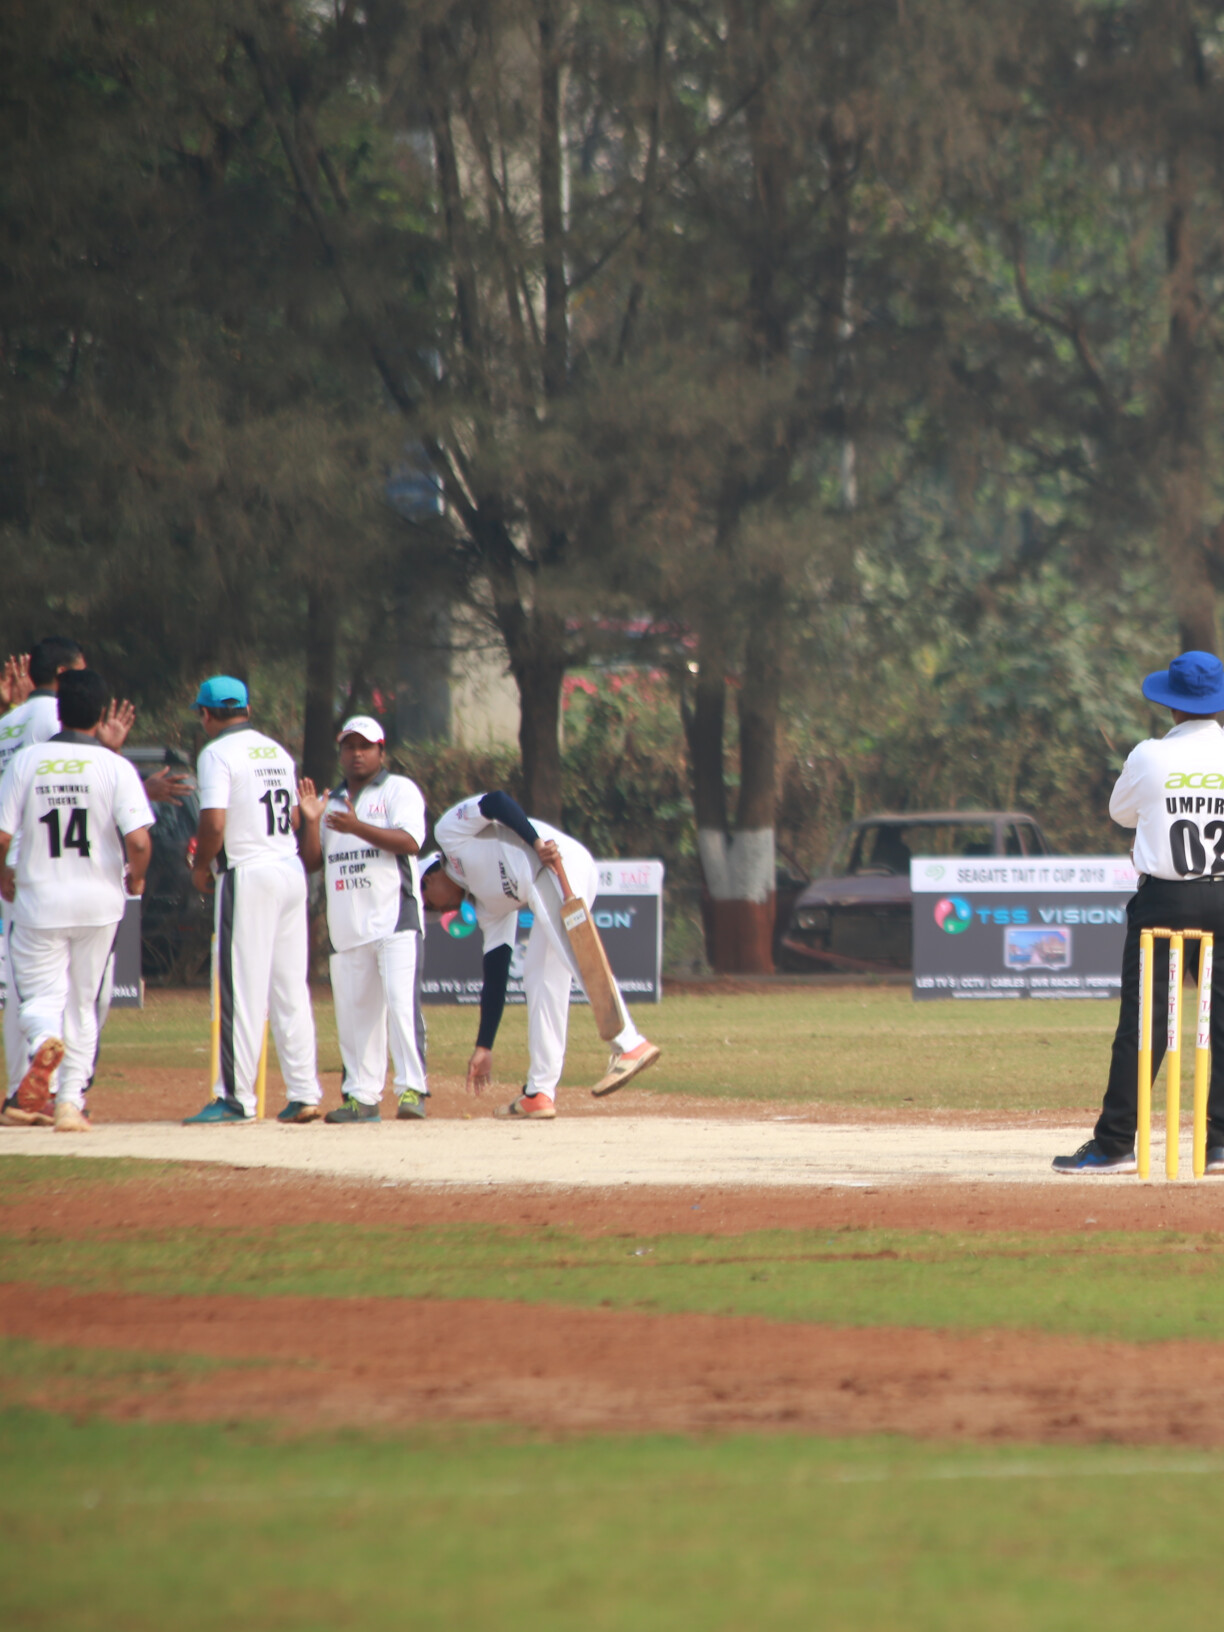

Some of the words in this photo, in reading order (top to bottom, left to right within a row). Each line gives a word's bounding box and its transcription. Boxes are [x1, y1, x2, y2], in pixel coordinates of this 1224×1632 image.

[248, 746, 278, 760] acer
[36, 759, 93, 775] acer
[53, 785, 89, 794] TWINKLE
[48, 796, 78, 806] TIGERS
[258, 788, 291, 836] 13
[38, 808, 90, 858] 14
[340, 866, 347, 876] IT
[349, 862, 366, 874] CUP
[957, 868, 1007, 883] SEAGATE
[1011, 868, 1034, 883] TAIT
[1039, 868, 1050, 883] IT
[1053, 868, 1076, 883] CUP
[1080, 867, 1105, 883] 2018
[346, 877, 371, 890] DBS
[620, 871, 650, 885] TAIT
[976, 908, 1030, 925] TSS
[1038, 907, 1124, 924] VISION
[421, 981, 440, 993] LED
